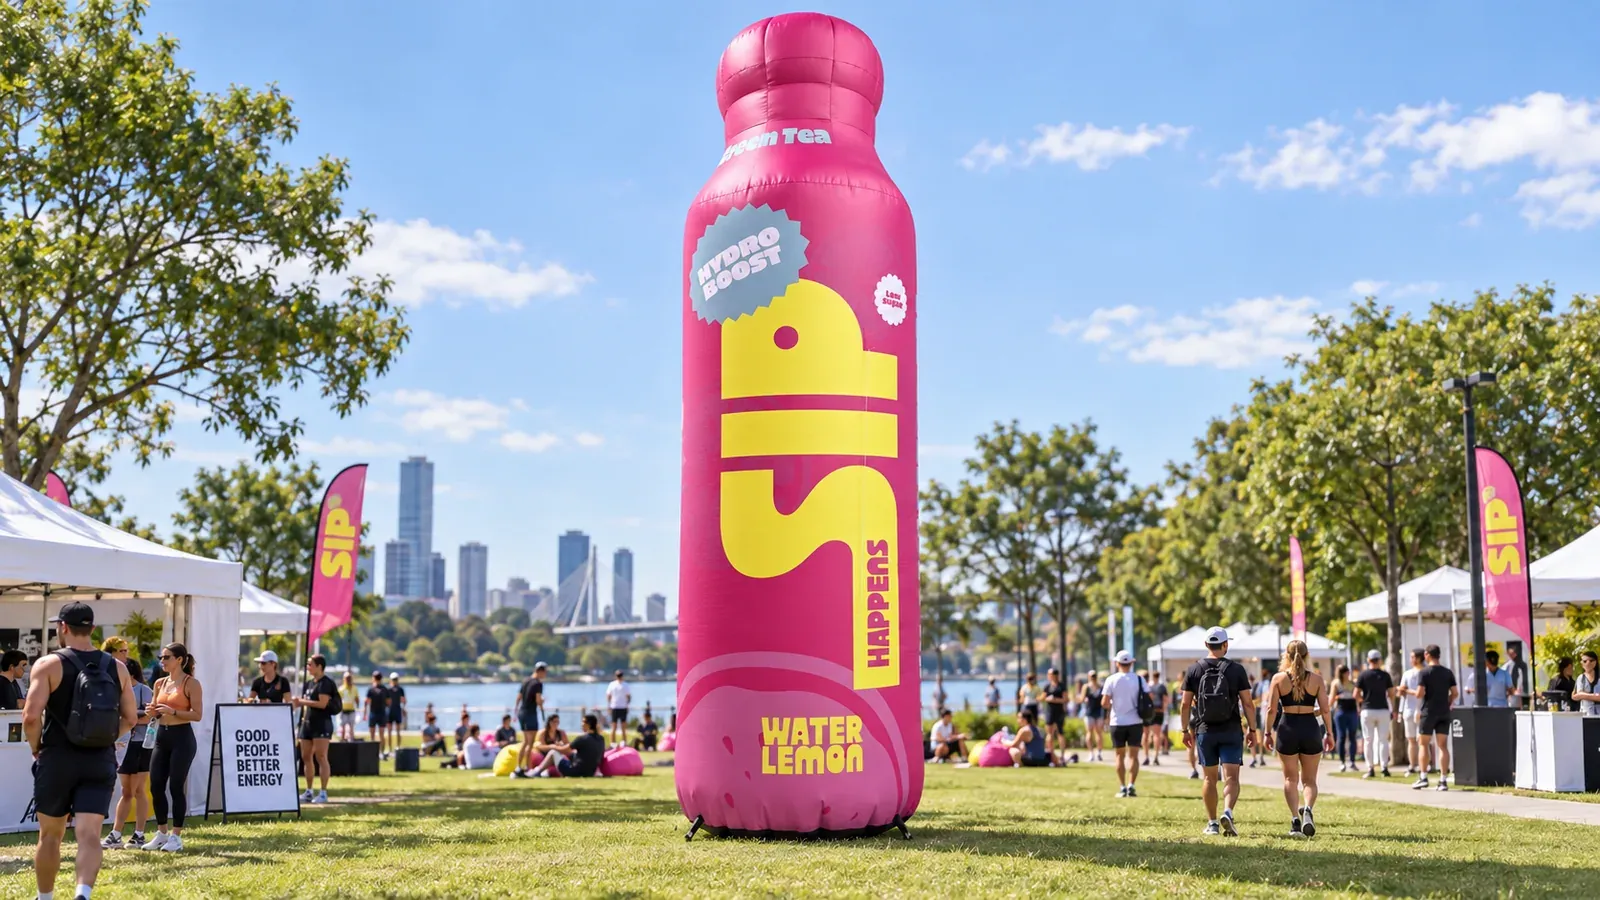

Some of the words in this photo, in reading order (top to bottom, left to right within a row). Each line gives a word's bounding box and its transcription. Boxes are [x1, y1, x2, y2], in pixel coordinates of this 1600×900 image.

[782, 128, 832, 144] Tea
[697, 226, 780, 286] HYDRO
[702, 245, 781, 301] BOOST
[720, 278, 900, 690] SIP
[866, 539, 890, 668] HAPPENS
[235, 729, 270, 742] GOOD
[761, 715, 863, 745] WATER
[236, 744, 280, 757] PEOPLE
[236, 759, 281, 772] BETTER
[762, 744, 863, 775] LEMON
[238, 773, 284, 787] ENERGY
